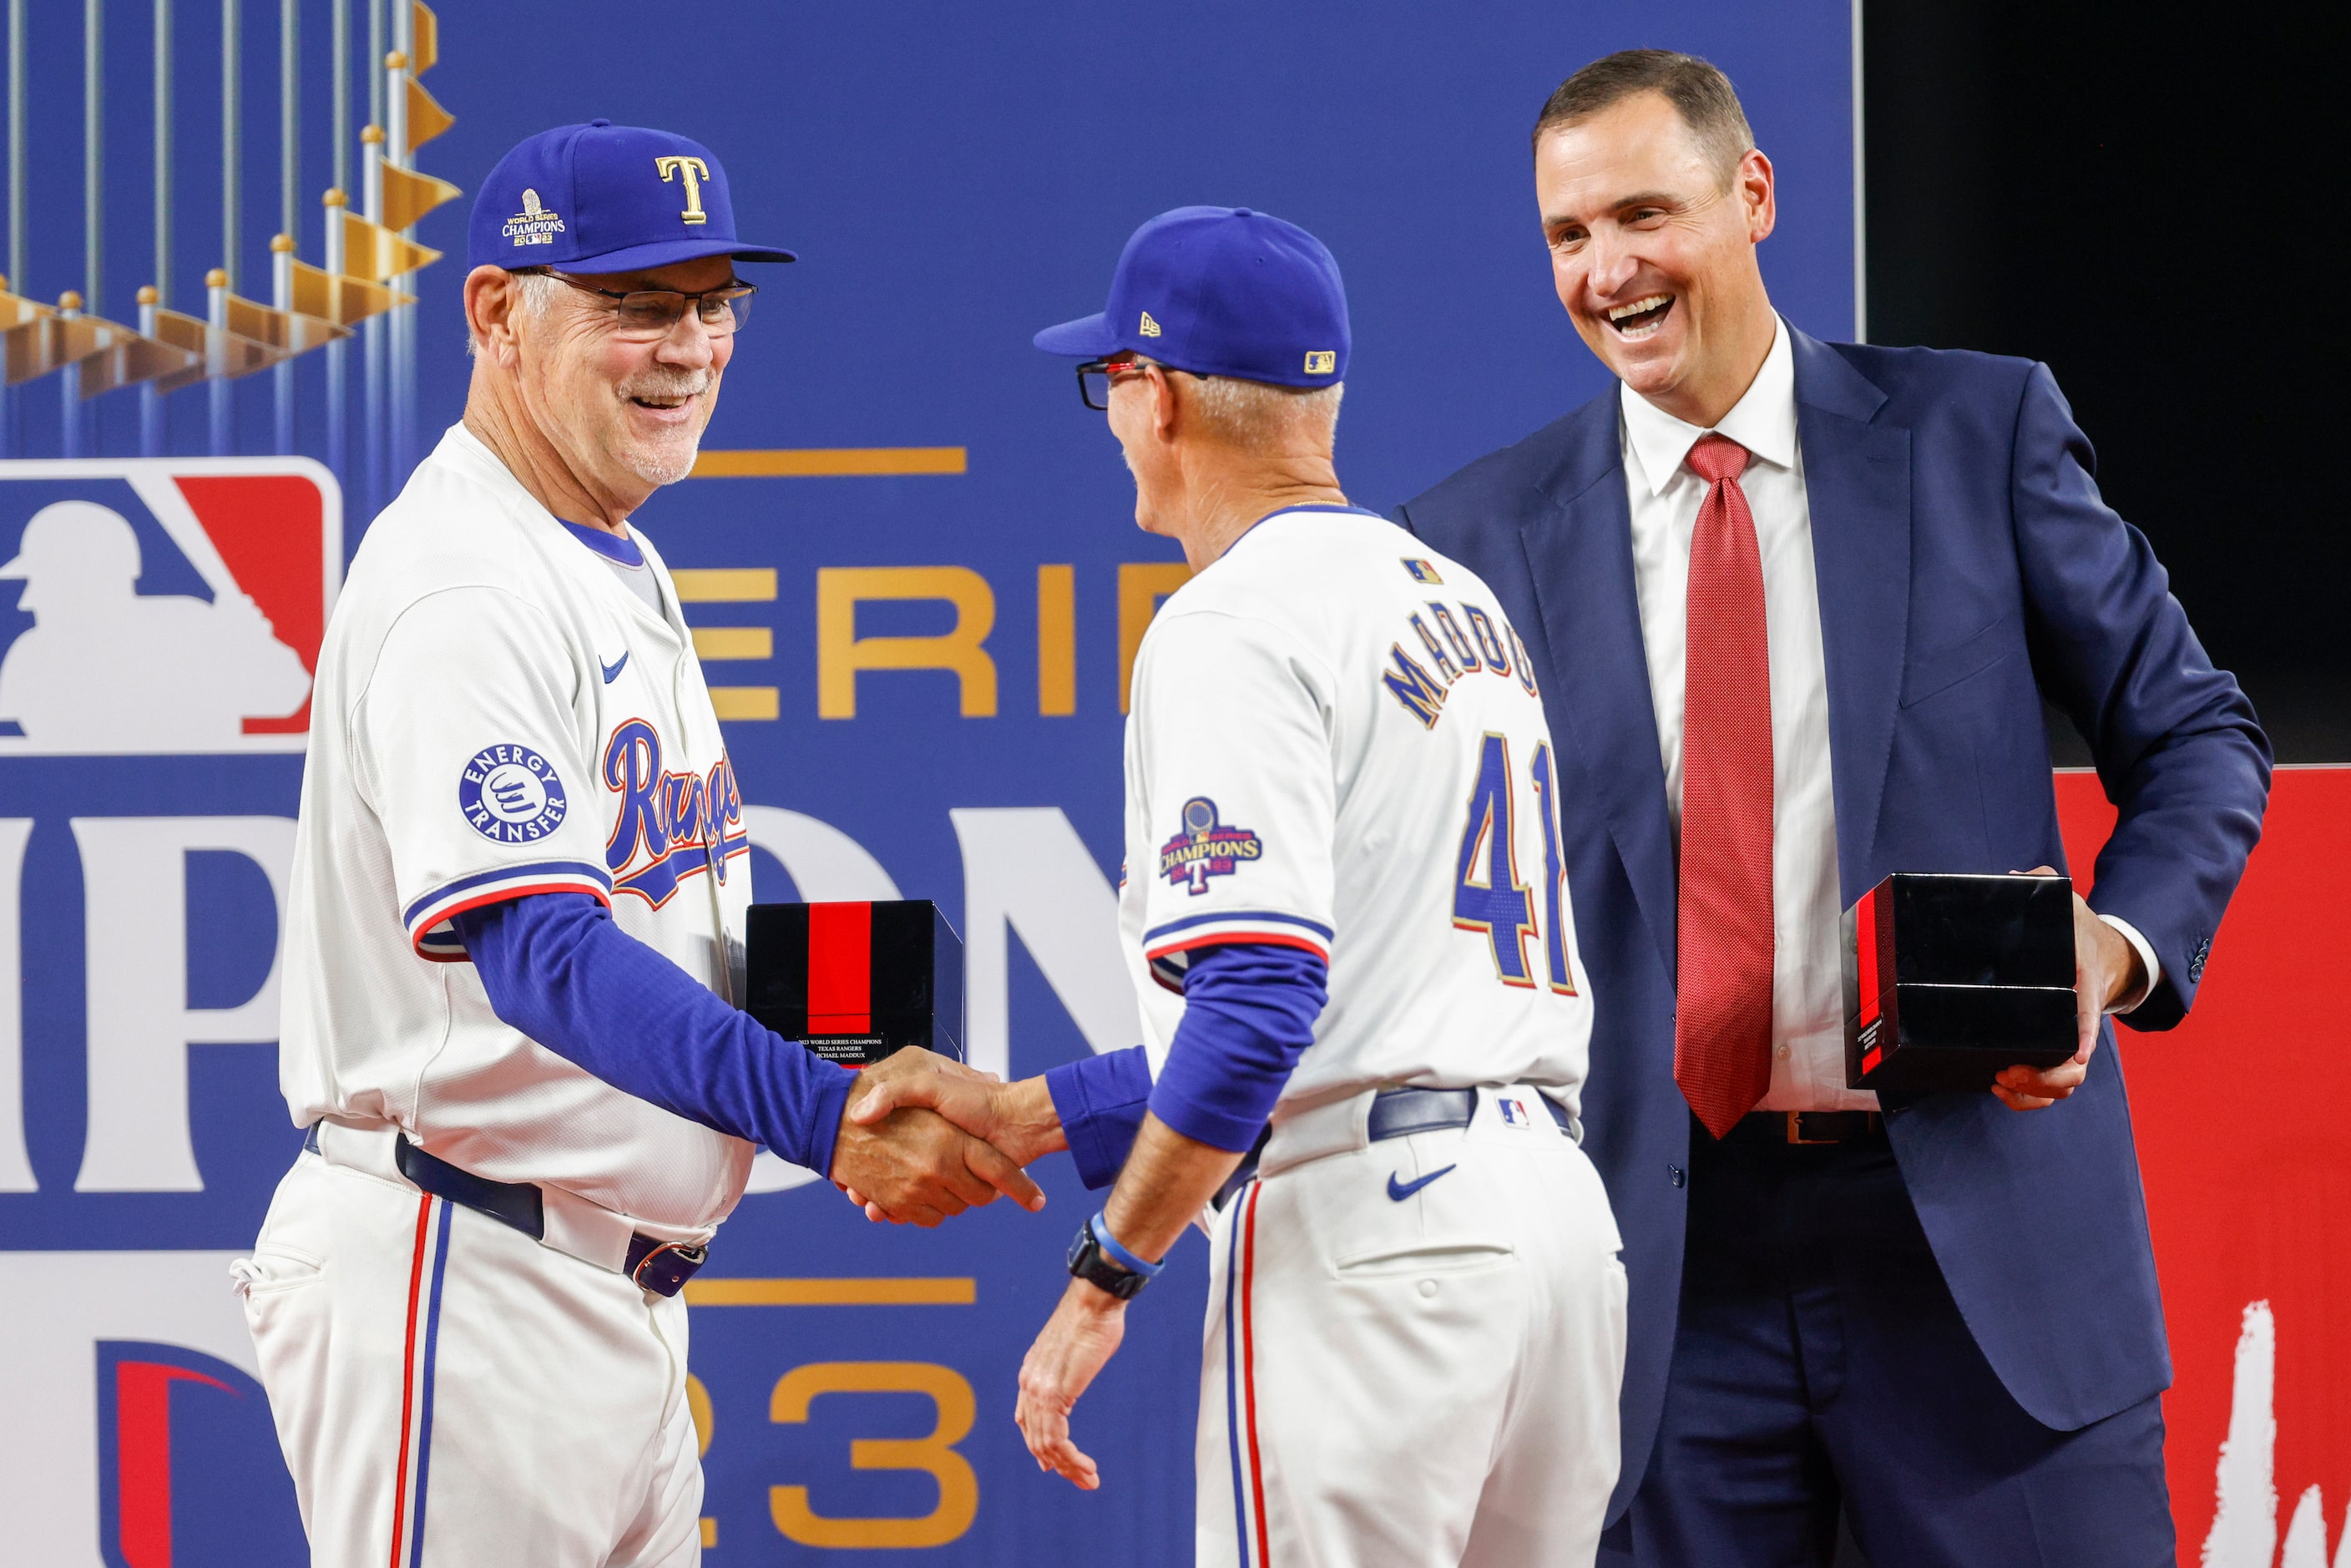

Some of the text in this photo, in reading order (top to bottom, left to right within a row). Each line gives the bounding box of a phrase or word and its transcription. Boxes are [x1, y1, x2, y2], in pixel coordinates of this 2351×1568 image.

[655, 155, 710, 225] T
[502, 219, 566, 237] CHAMPIONS
[508, 213, 559, 225] WORLD SERIES
[464, 746, 558, 785] ENERGY
[464, 797, 565, 842] TRANSFER
[1159, 839, 1259, 874] CHAMPIONS
[1185, 857, 1211, 893] T
[1451, 730, 1578, 997] 41
